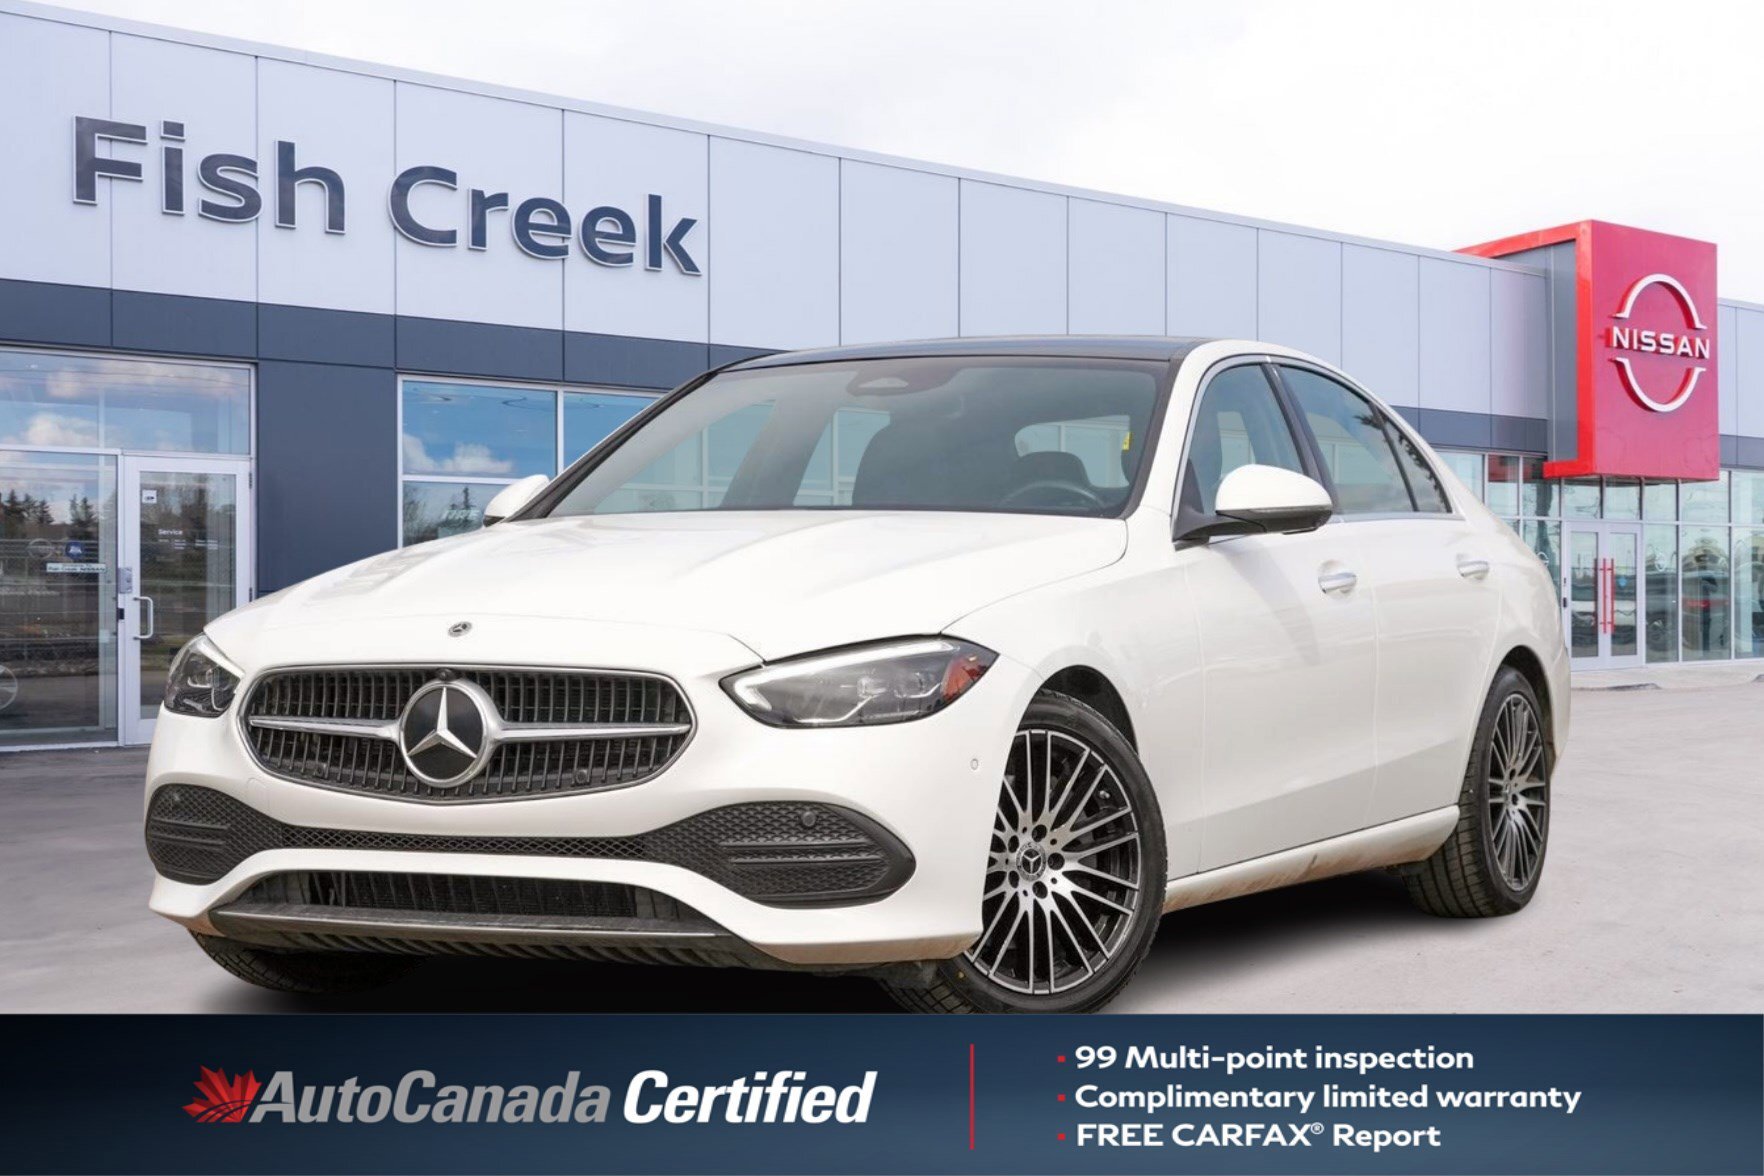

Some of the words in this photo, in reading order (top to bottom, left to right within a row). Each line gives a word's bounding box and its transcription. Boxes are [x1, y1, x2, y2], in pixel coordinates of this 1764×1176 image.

[72, 115, 346, 234] Fish
[387, 164, 703, 276] Creek
[1611, 326, 1711, 360] NISSAN
